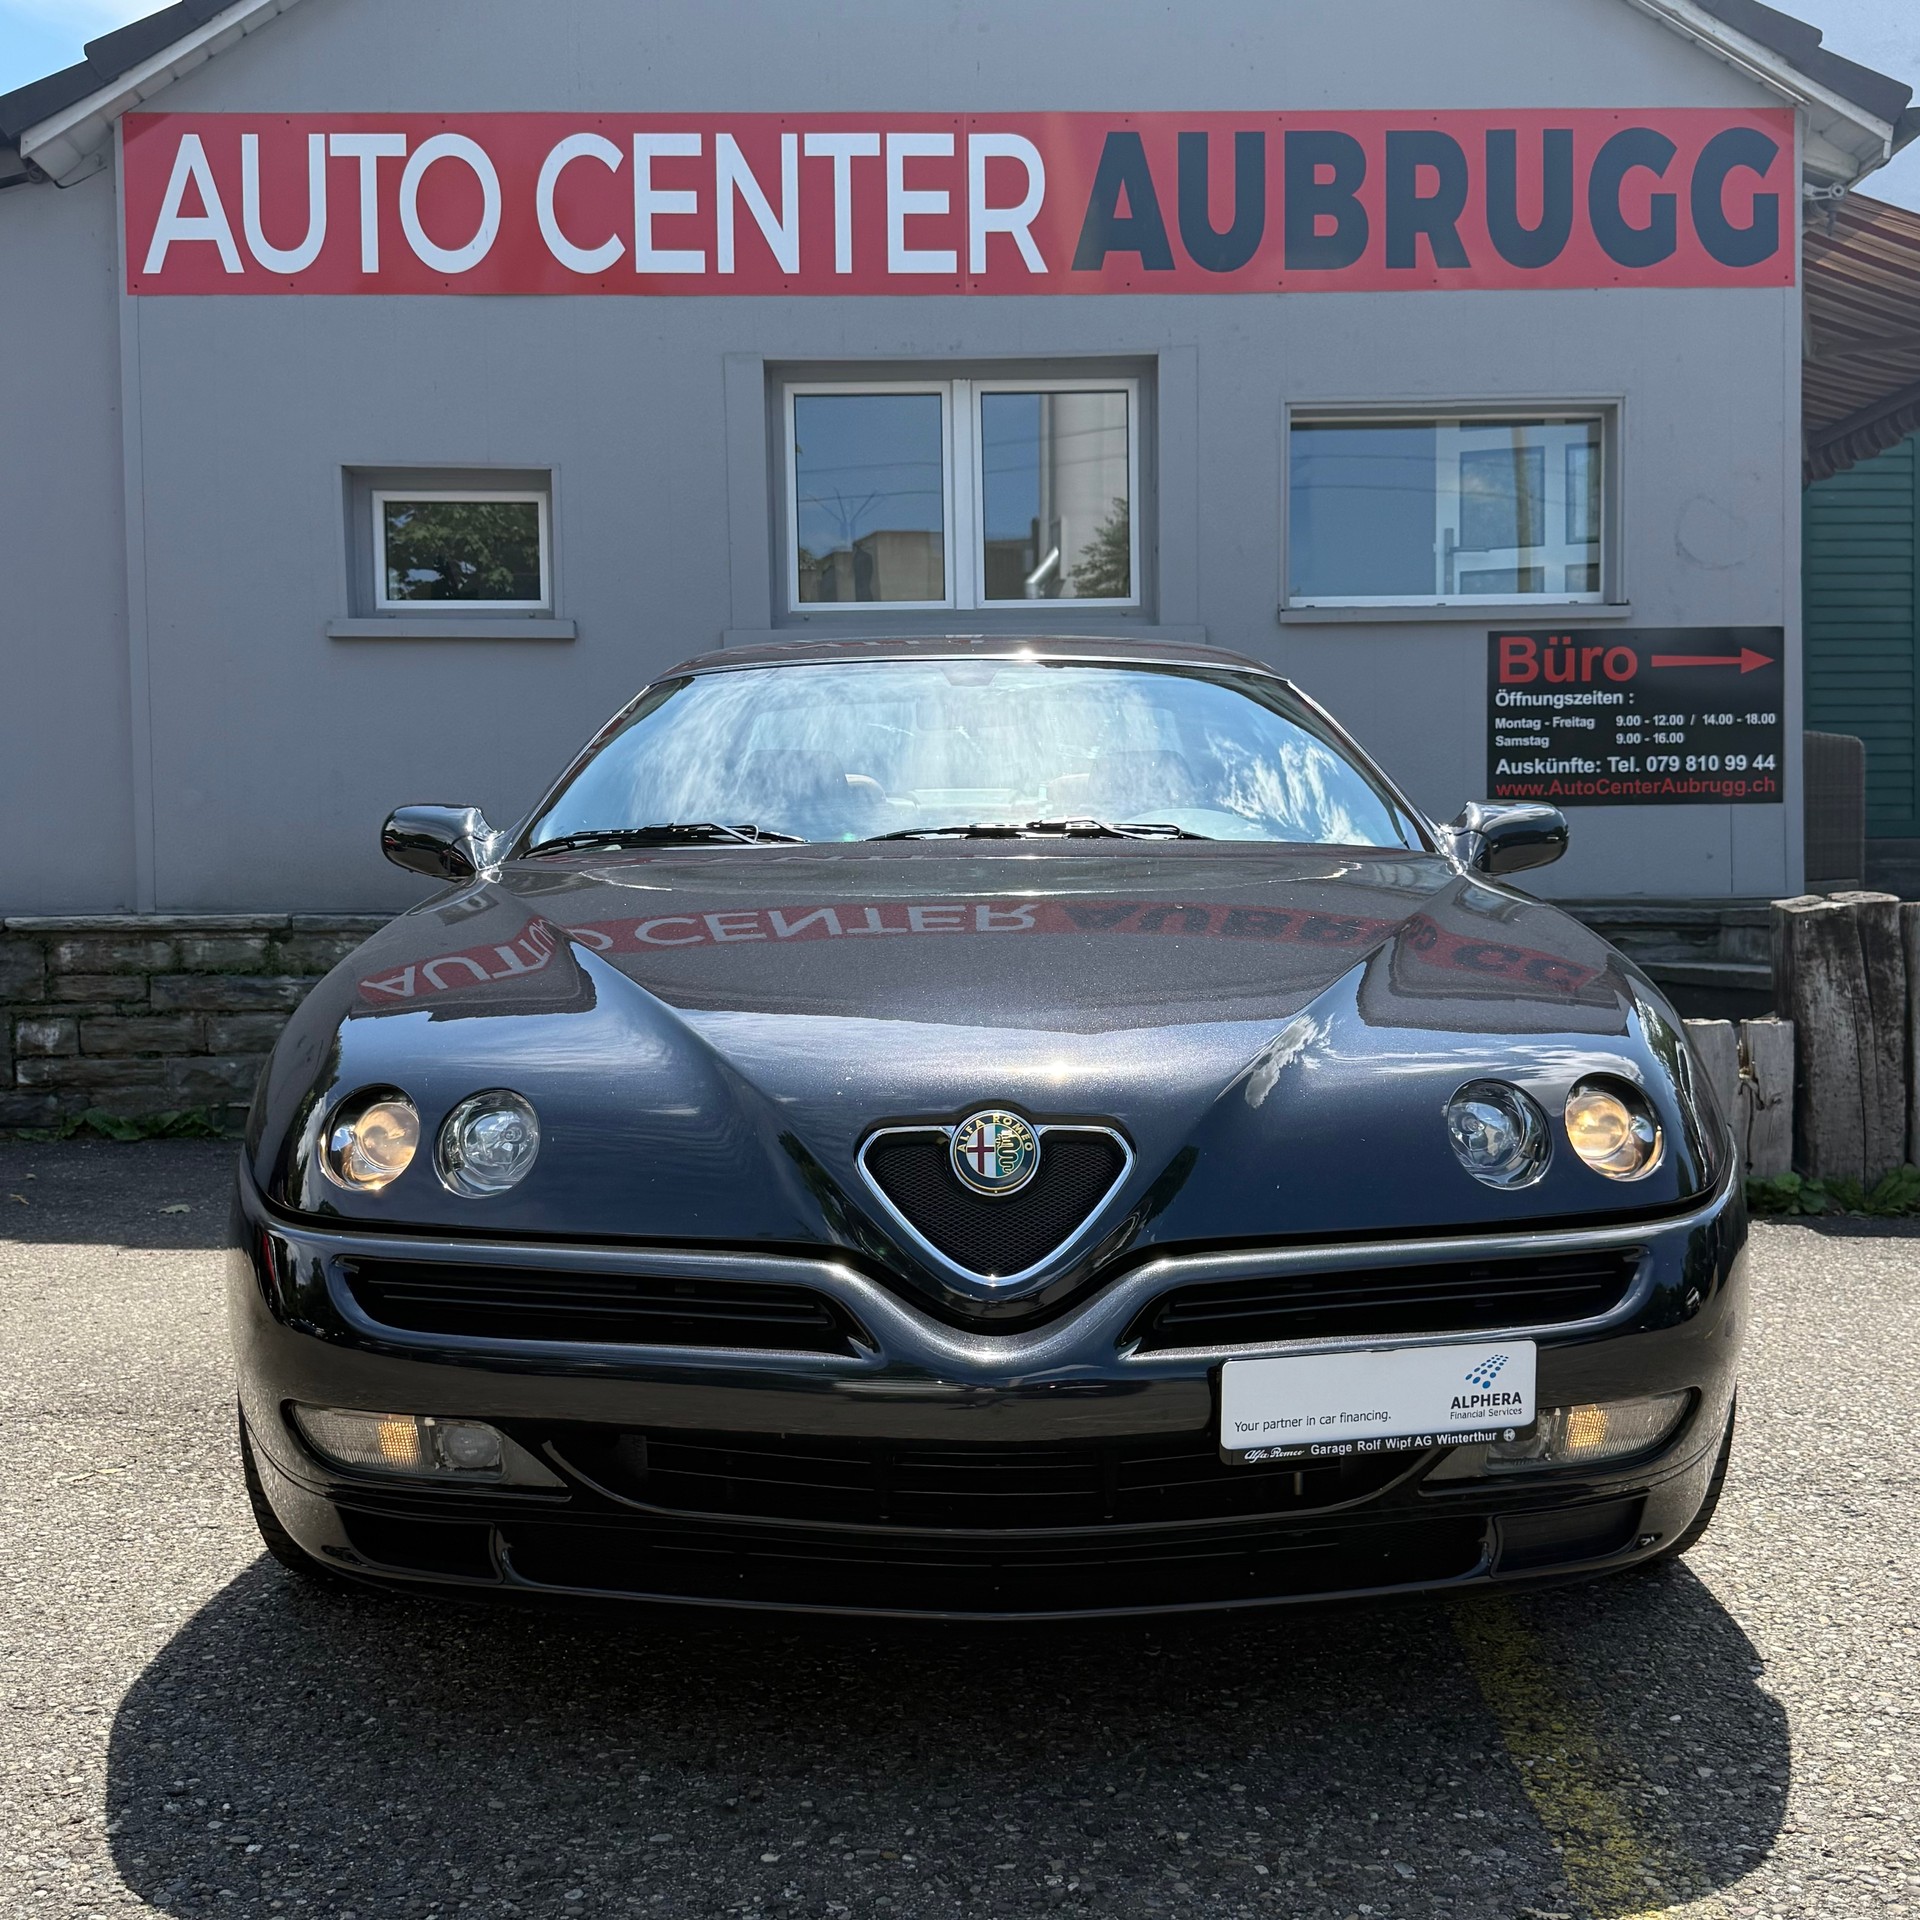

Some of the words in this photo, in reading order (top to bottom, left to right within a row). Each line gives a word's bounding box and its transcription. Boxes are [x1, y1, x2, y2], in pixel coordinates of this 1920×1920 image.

[142, 132, 502, 274] AUTO
[536, 132, 1048, 274] CENTER
[1072, 126, 1781, 273] AUBRUGG
[1500, 636, 1638, 684] Büro
[1495, 717, 1541, 731] Montag
[1552, 716, 1595, 730] Freitag
[1616, 715, 1641, 727] 9.00
[1653, 714, 1684, 726] 12.00
[1702, 713, 1733, 726] 14.00
[1745, 713, 1776, 725] 18.00
[1495, 734, 1550, 749] Samstag
[1616, 733, 1641, 744] 9.00
[1653, 732, 1684, 744] 16.00
[1496, 757, 1601, 775] Auskünfte:
[1607, 756, 1641, 773] Tel.
[1646, 755, 1680, 773] 079
[1685, 755, 1719, 772] 810
[1724, 754, 1747, 772] 99
[1752, 754, 1776, 771] 44
[1496, 777, 1775, 797] www.AutoCenterAubrugg.ch
[957, 1119, 986, 1153] ALFA
[992, 1113, 1033, 1151] ROMEO
[1451, 1392, 1522, 1410] ALPHERA
[1234, 1421, 1260, 1433] Your
[1263, 1418, 1303, 1432] partner
[1306, 1415, 1316, 1426] in
[1320, 1415, 1337, 1425] car
[1340, 1410, 1391, 1423] financing.
[1450, 1409, 1486, 1420] Financial
[1488, 1407, 1522, 1417] Services
[1310, 1441, 1352, 1456] Garage
[1357, 1439, 1382, 1452] Rolf
[1385, 1437, 1412, 1450] Wipf
[1414, 1435, 1432, 1446] AG
[1437, 1431, 1498, 1445] Winterthur
